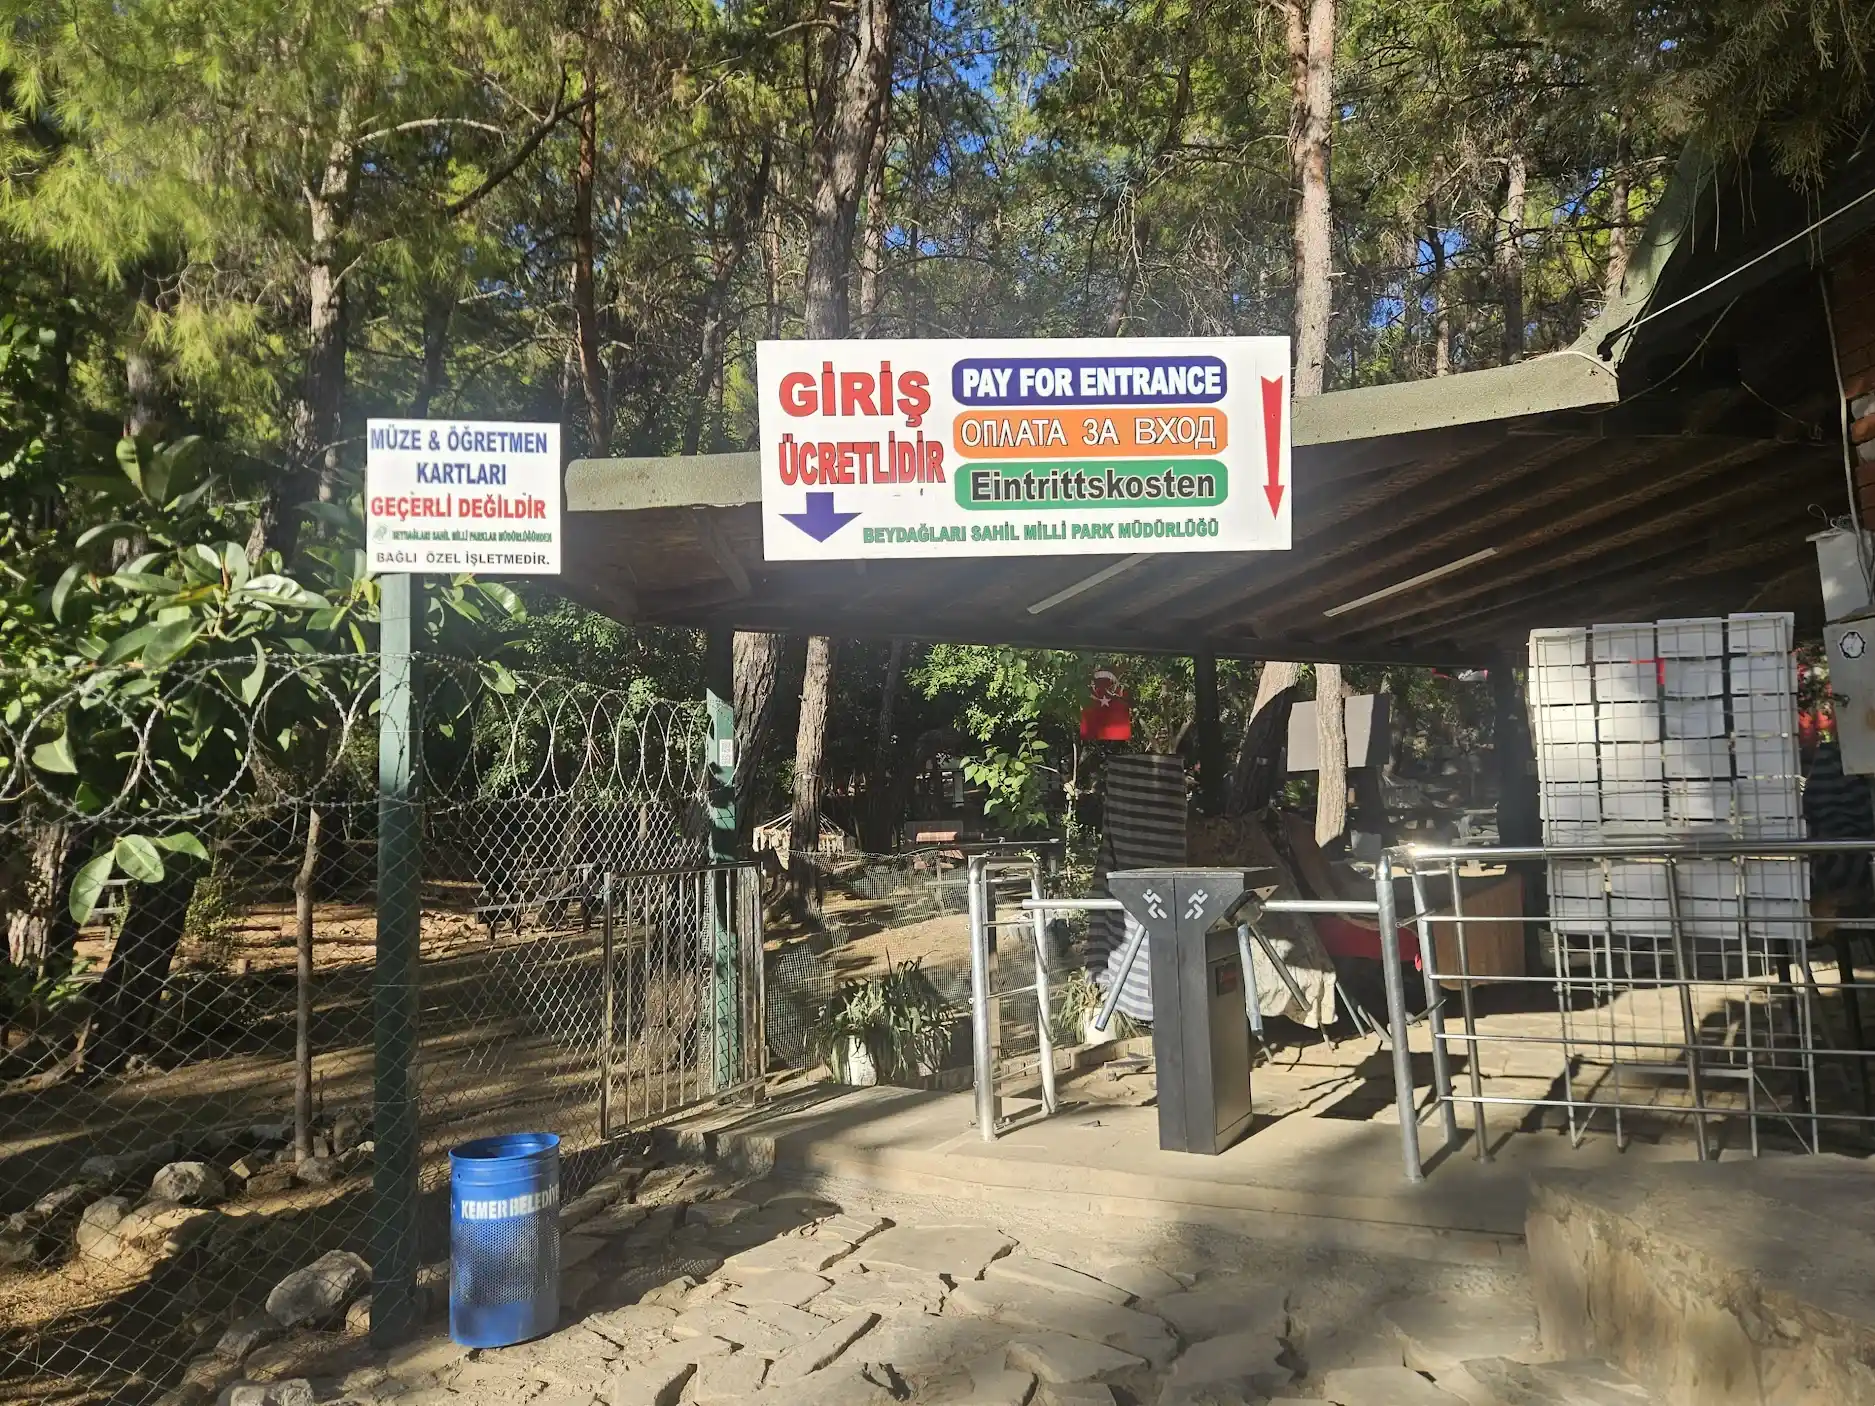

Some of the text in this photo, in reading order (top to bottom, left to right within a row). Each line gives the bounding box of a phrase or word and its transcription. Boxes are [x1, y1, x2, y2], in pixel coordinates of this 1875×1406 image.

[779, 361, 931, 426] GİRİŞ
[963, 366, 1221, 398] PAY FOR ENTRANCE
[371, 425, 548, 453] MÜZE & ÖĞRETMEN
[961, 416, 1216, 449] ОПЛАТА ЗА ВХОД
[779, 431, 946, 485] ÜCRETLİDİR
[417, 462, 506, 484] KARTLARI
[970, 468, 1216, 502] Eintrittskosten
[371, 493, 546, 522] GEÇERLİ DEĞİLDİR
[863, 520, 1218, 544] BEYDAĞLARI SAHİL MİLLİ PARK MÜDÜRLÜĞÜ
[377, 550, 550, 566] BAĞLI ÖZEL İŞLETMEDİR.
[462, 1200, 507, 1219] KEMER
